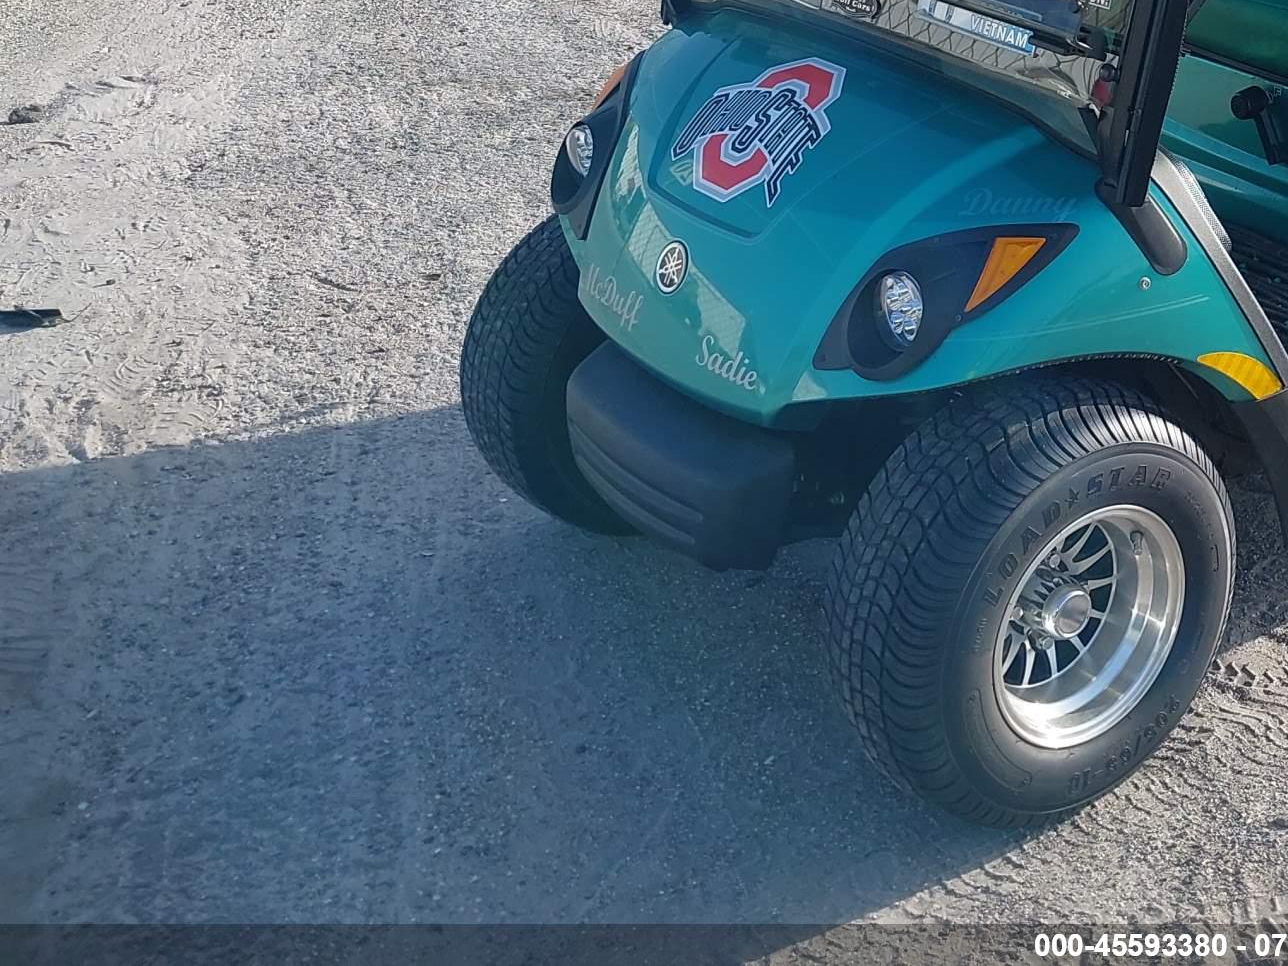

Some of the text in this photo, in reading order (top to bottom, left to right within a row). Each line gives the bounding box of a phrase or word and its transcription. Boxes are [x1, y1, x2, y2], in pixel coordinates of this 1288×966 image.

[970, 14, 1030, 49] VIETNAM
[958, 187, 1079, 223] Danny
[695, 334, 760, 391] Sadie
[984, 464, 1174, 609] LOAD STAR
